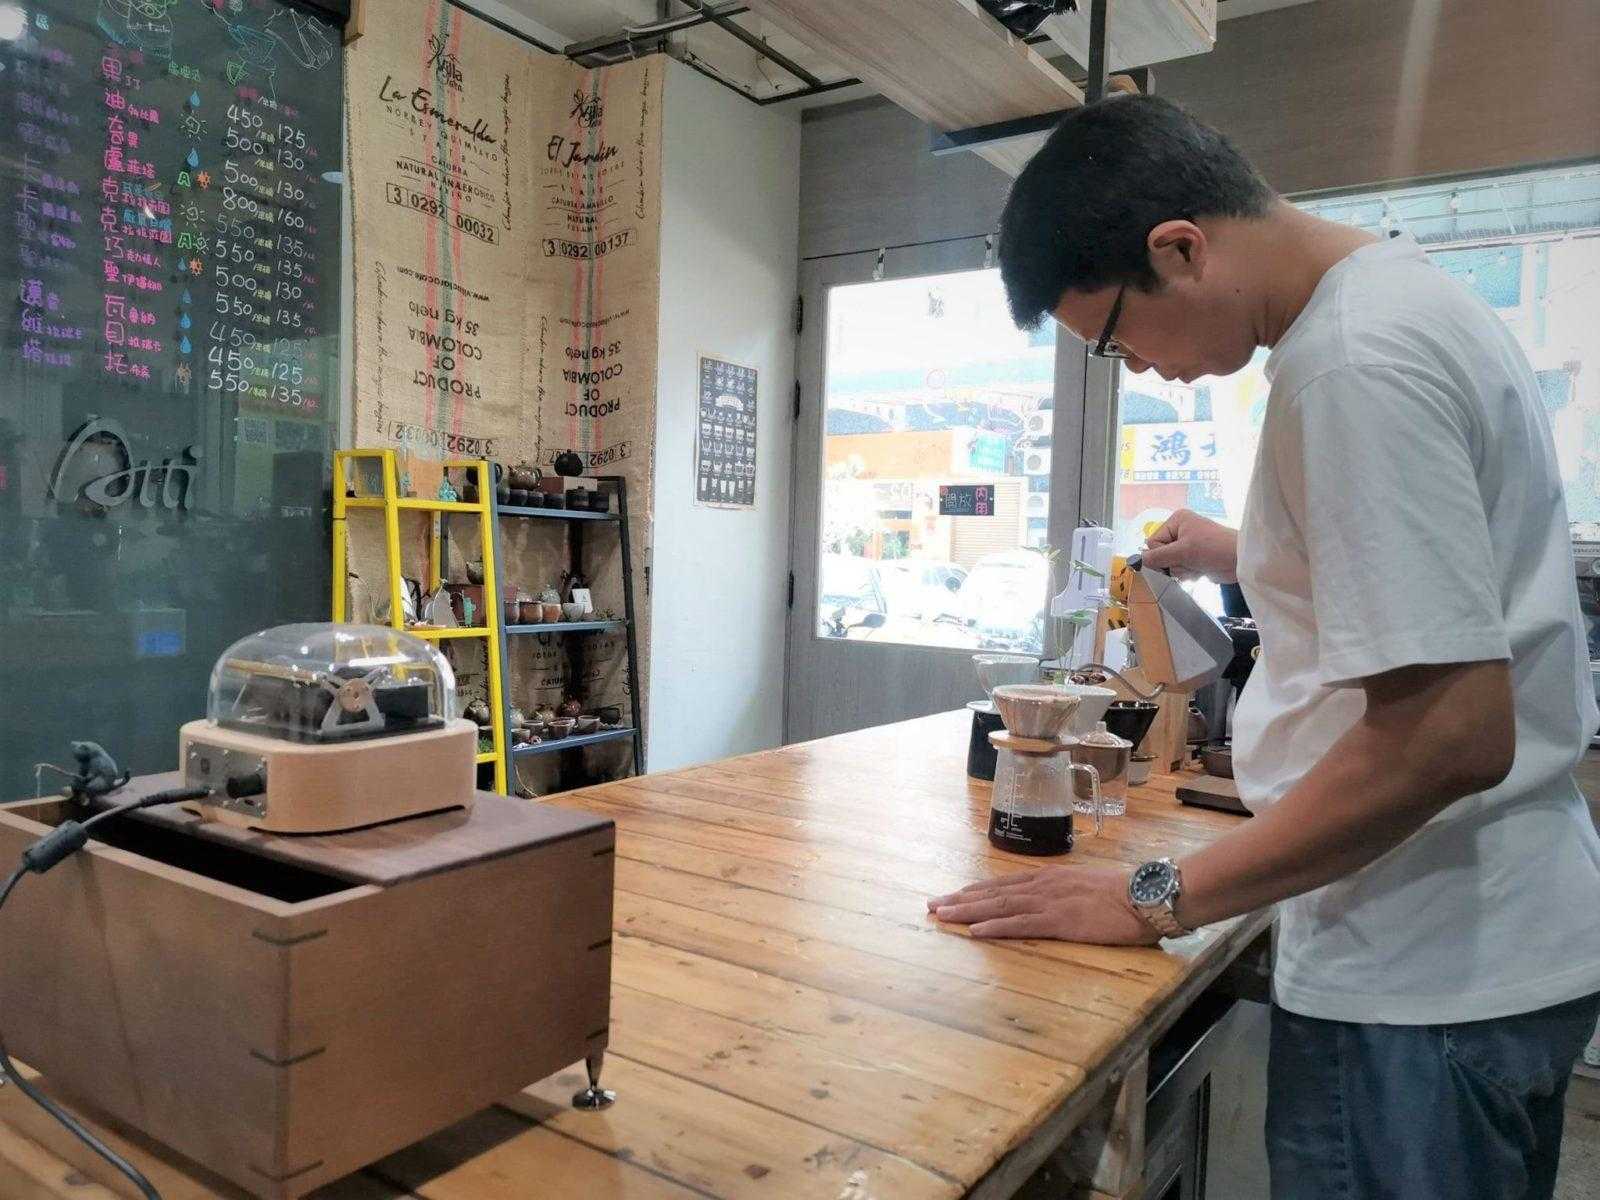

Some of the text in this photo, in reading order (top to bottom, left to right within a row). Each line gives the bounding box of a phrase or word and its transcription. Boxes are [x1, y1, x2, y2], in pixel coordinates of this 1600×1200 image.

[227, 104, 263, 128] 450
[279, 124, 305, 149] 125
[379, 75, 496, 143] La Esmeralda
[226, 126, 263, 155] 500
[278, 149, 304, 170] 130
[547, 135, 564, 161] El
[224, 160, 258, 186] 500
[277, 180, 304, 200] 130
[396, 160, 439, 180] NATURAL
[223, 187, 257, 212] 800
[278, 208, 304, 228] 160
[393, 188, 494, 242] 3 0292 00032
[567, 214, 598, 224] NATURAL
[216, 213, 255, 239] 550
[277, 234, 304, 257] 135
[547, 232, 629, 258] 3 0292 00137
[215, 239, 254, 263] 550
[277, 260, 302, 278] 135
[216, 265, 256, 290] 500
[276, 281, 302, 300] 130
[216, 292, 252, 316] 550
[277, 309, 301, 327] 135
[409, 301, 479, 336] 35 kg neto
[210, 321, 255, 346] 450
[408, 326, 482, 361] COLOMBIA
[565, 340, 621, 360] 35 kg neto
[208, 346, 254, 371] 450
[272, 363, 302, 385] 125
[433, 355, 455, 370] OF
[562, 363, 623, 385] COLOMBIA
[208, 369, 249, 391] 550
[271, 385, 302, 405] 135
[413, 371, 481, 400] PRODUCT
[585, 389, 600, 401] OF
[564, 397, 620, 418] PRODUCT
[447, 434, 480, 454] 0292
[485, 440, 493, 454] 3
